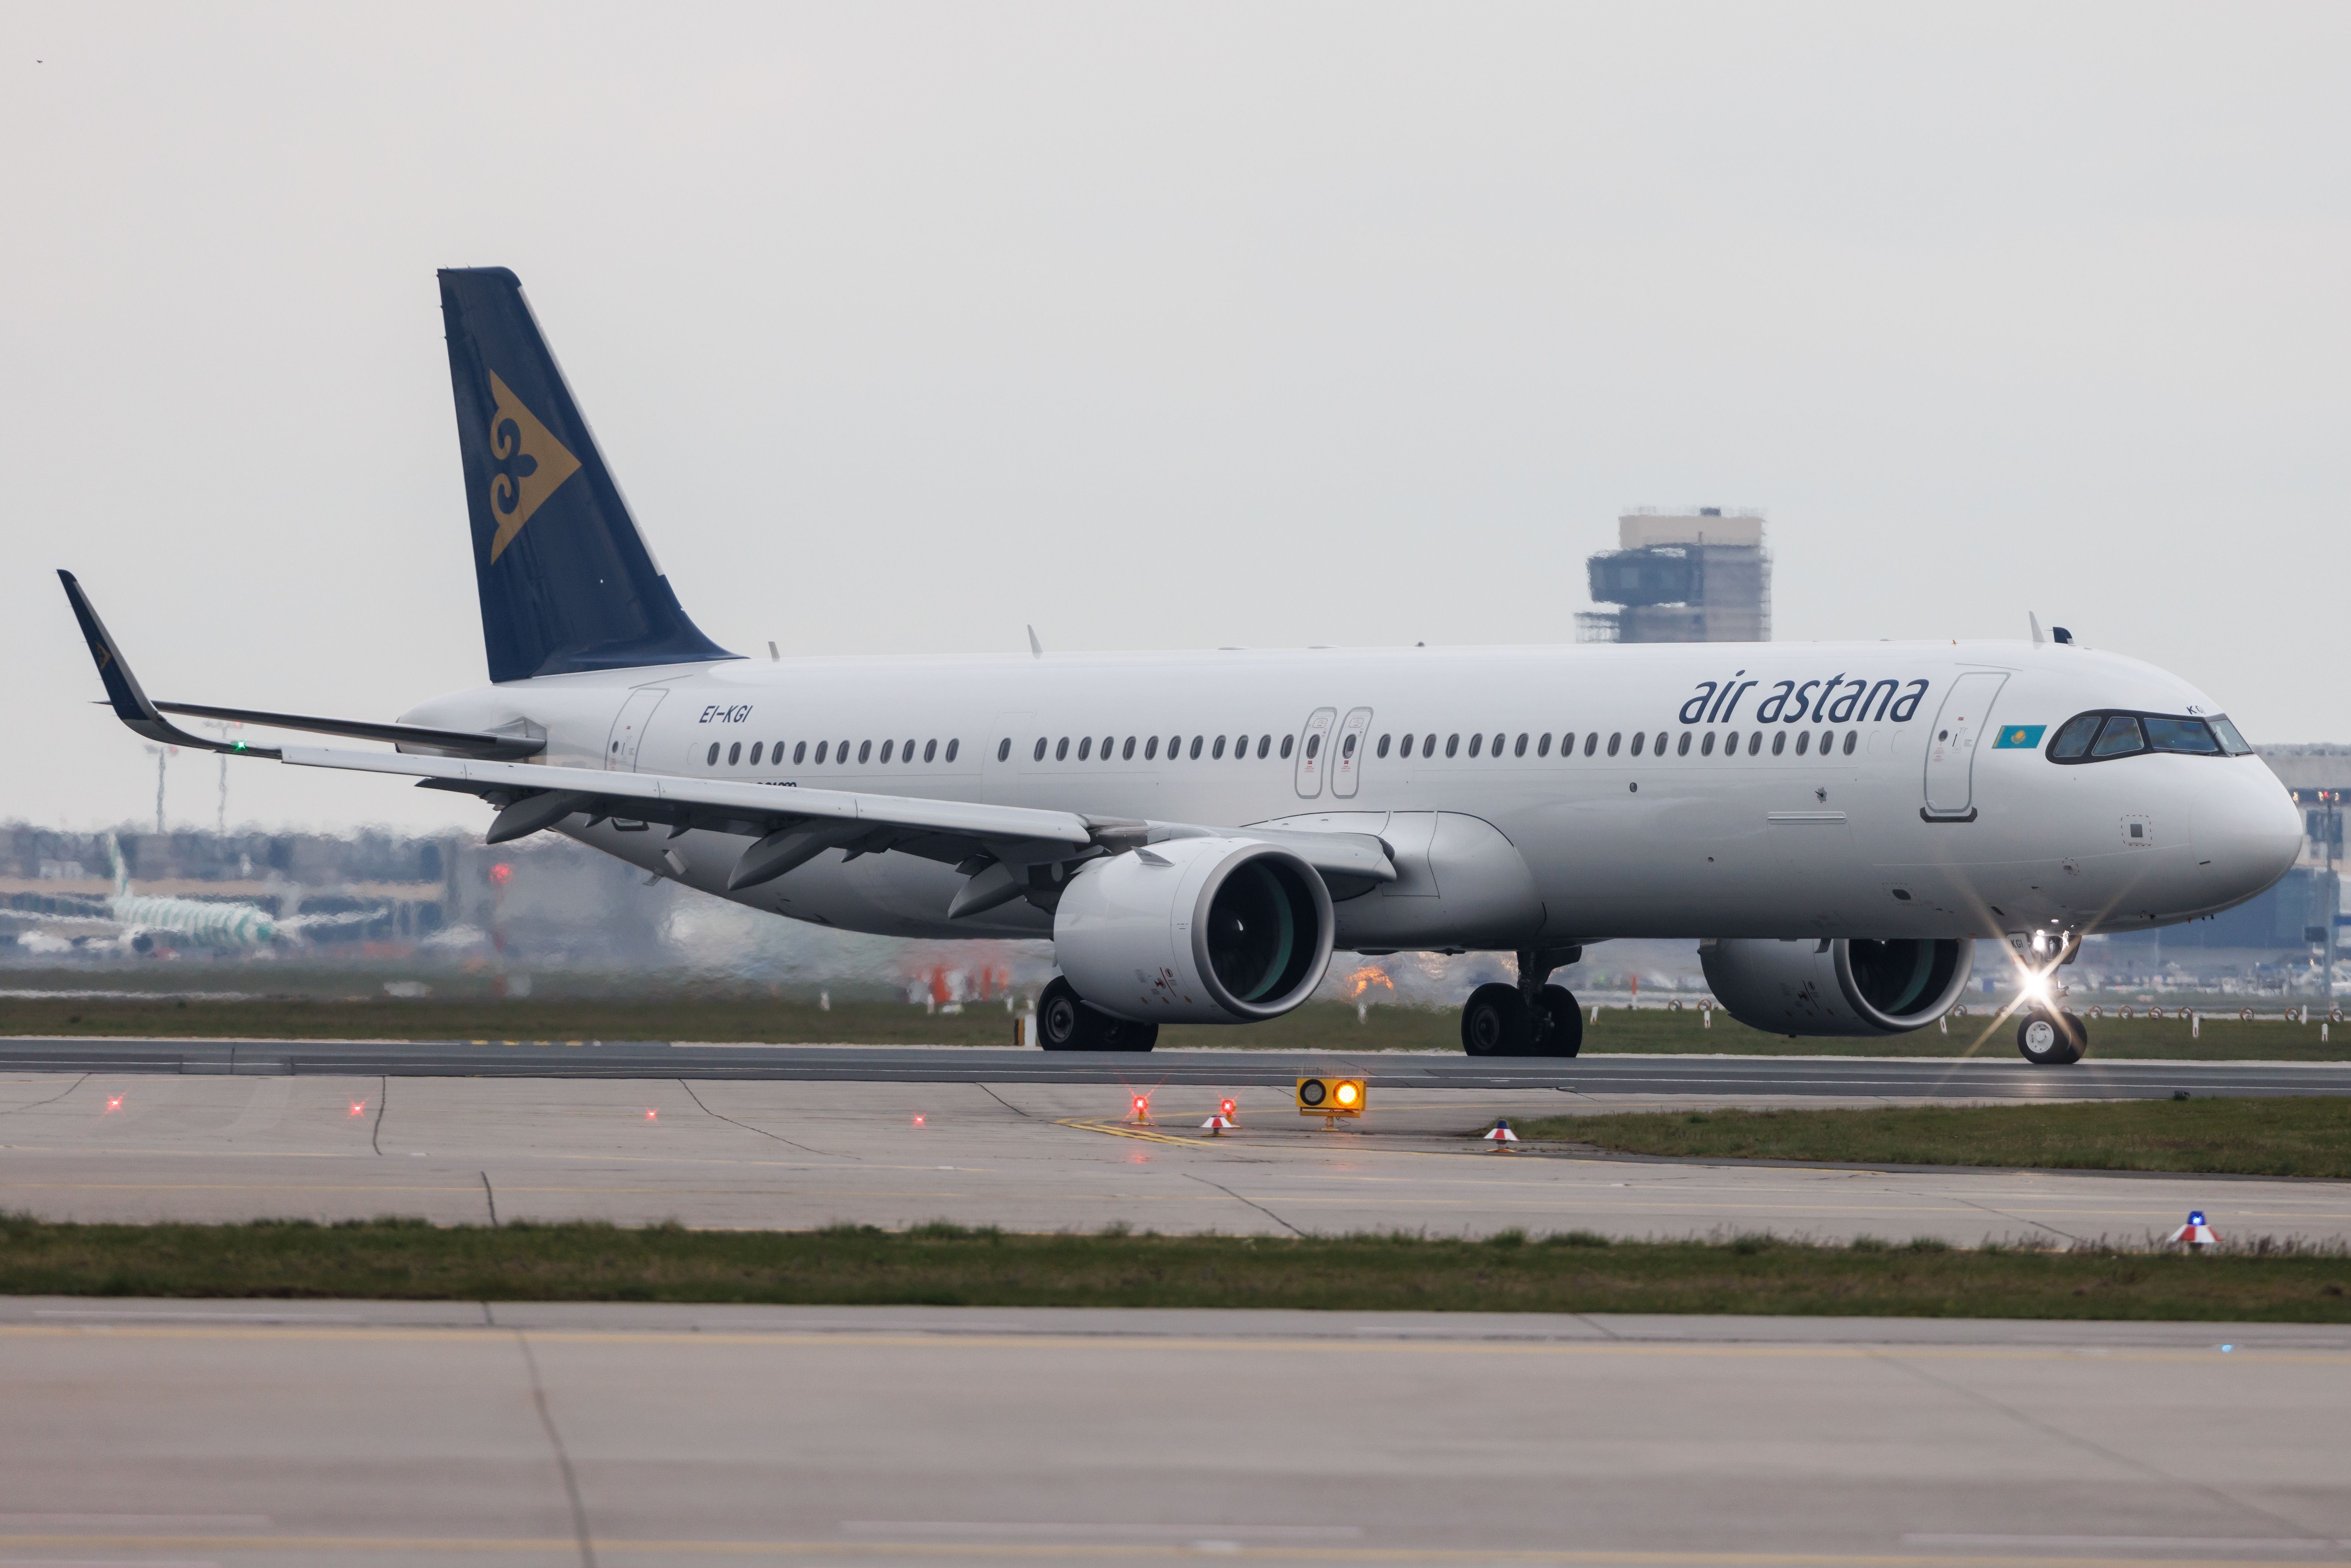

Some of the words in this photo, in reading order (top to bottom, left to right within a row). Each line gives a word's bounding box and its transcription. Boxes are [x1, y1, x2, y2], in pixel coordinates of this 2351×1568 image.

[1679, 670, 1759, 724] air
[1756, 672, 1929, 724] astana
[699, 705, 753, 723] EI-KGI
[2010, 939, 2023, 948] KGI
